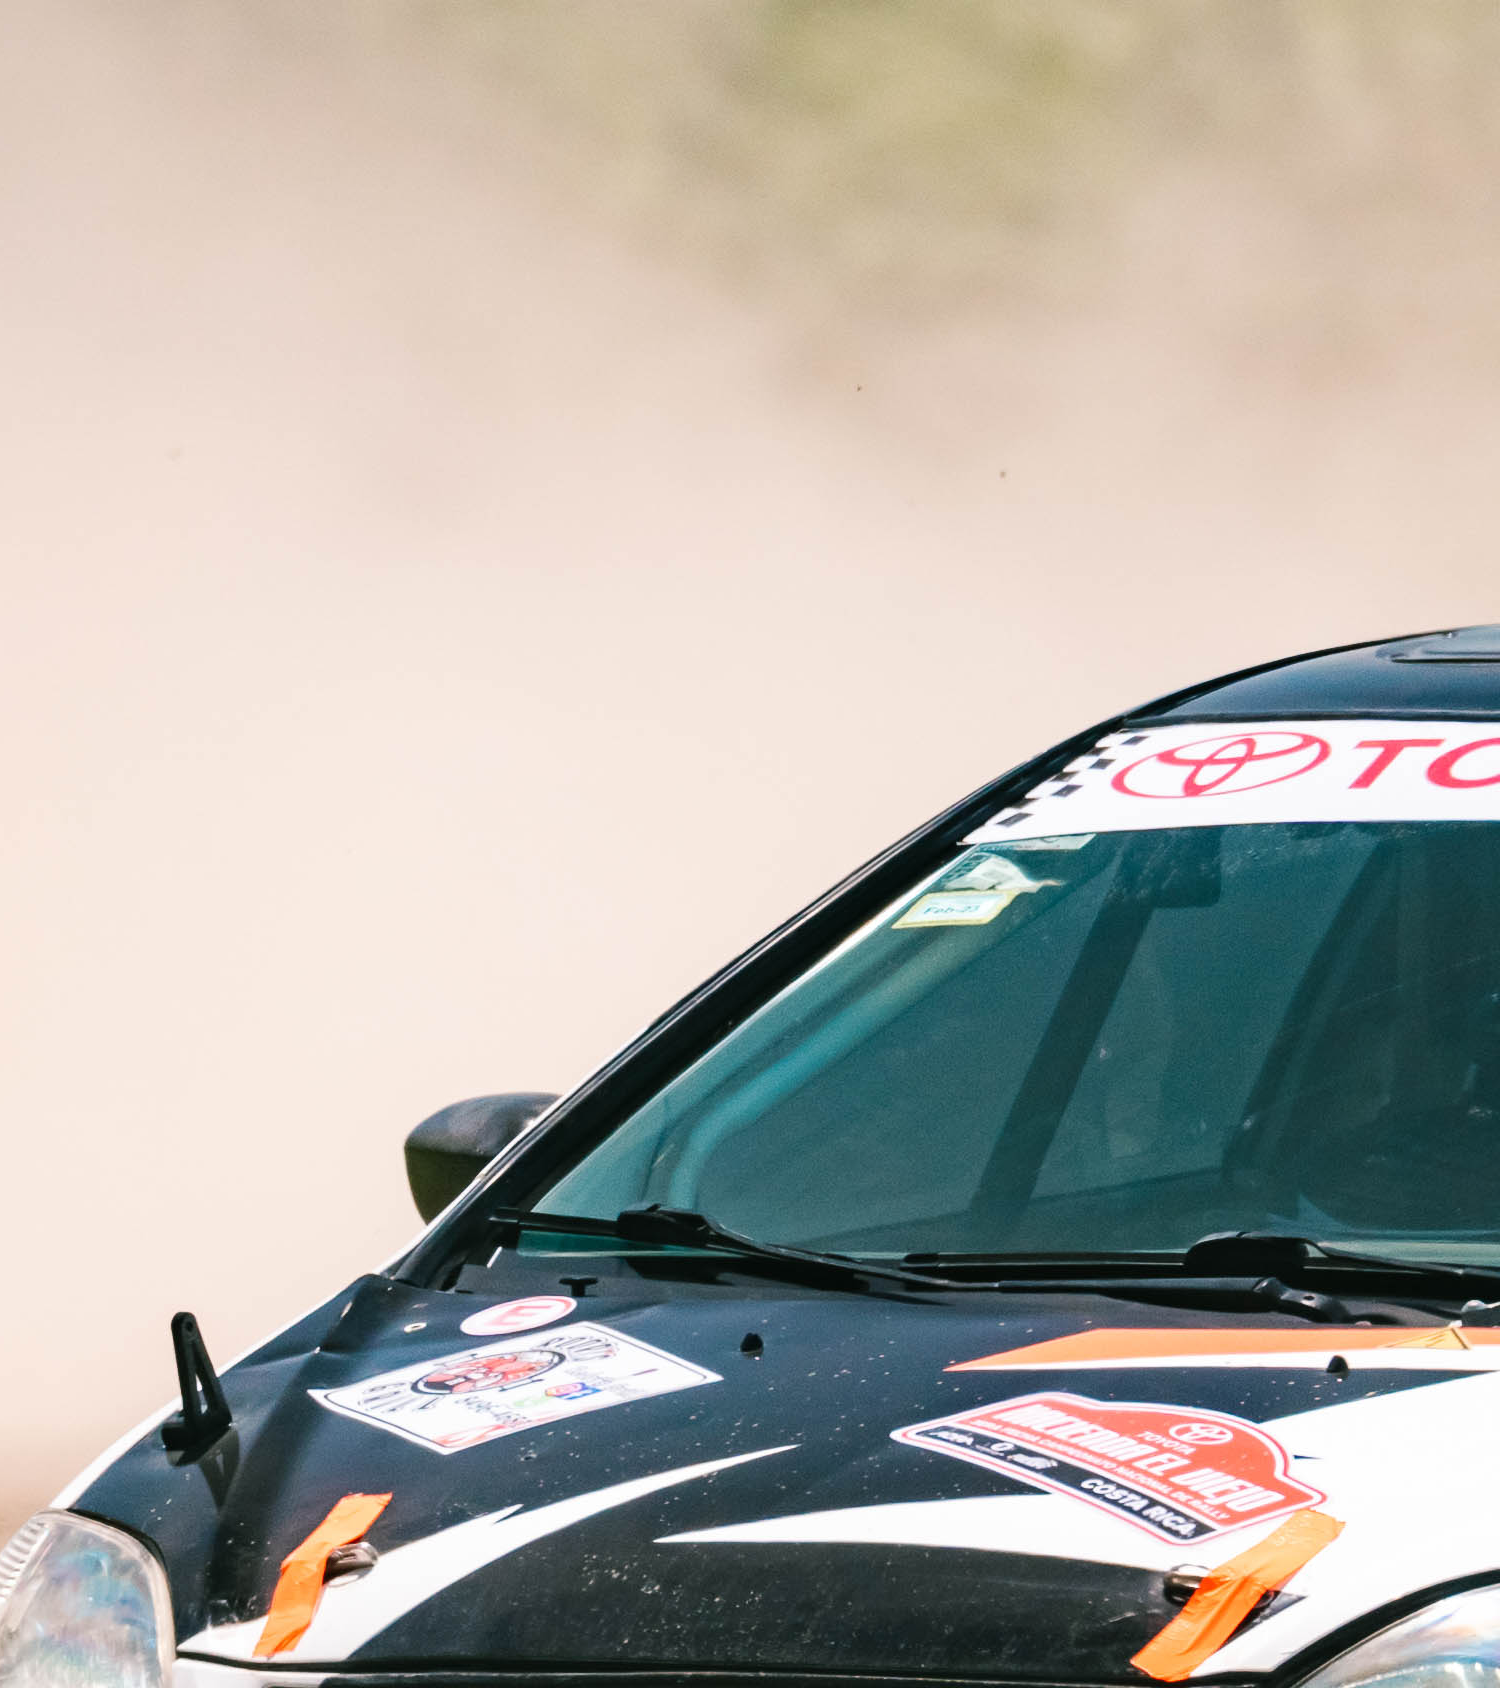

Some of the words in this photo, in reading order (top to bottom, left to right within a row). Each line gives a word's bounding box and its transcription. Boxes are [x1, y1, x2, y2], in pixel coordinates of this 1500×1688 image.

[1137, 1430, 1197, 1455] TOYOTA
[1079, 1476, 1150, 1513] COSTA
[1131, 1452, 1193, 1477] EL
[1168, 1467, 1287, 1513] VIEJO
